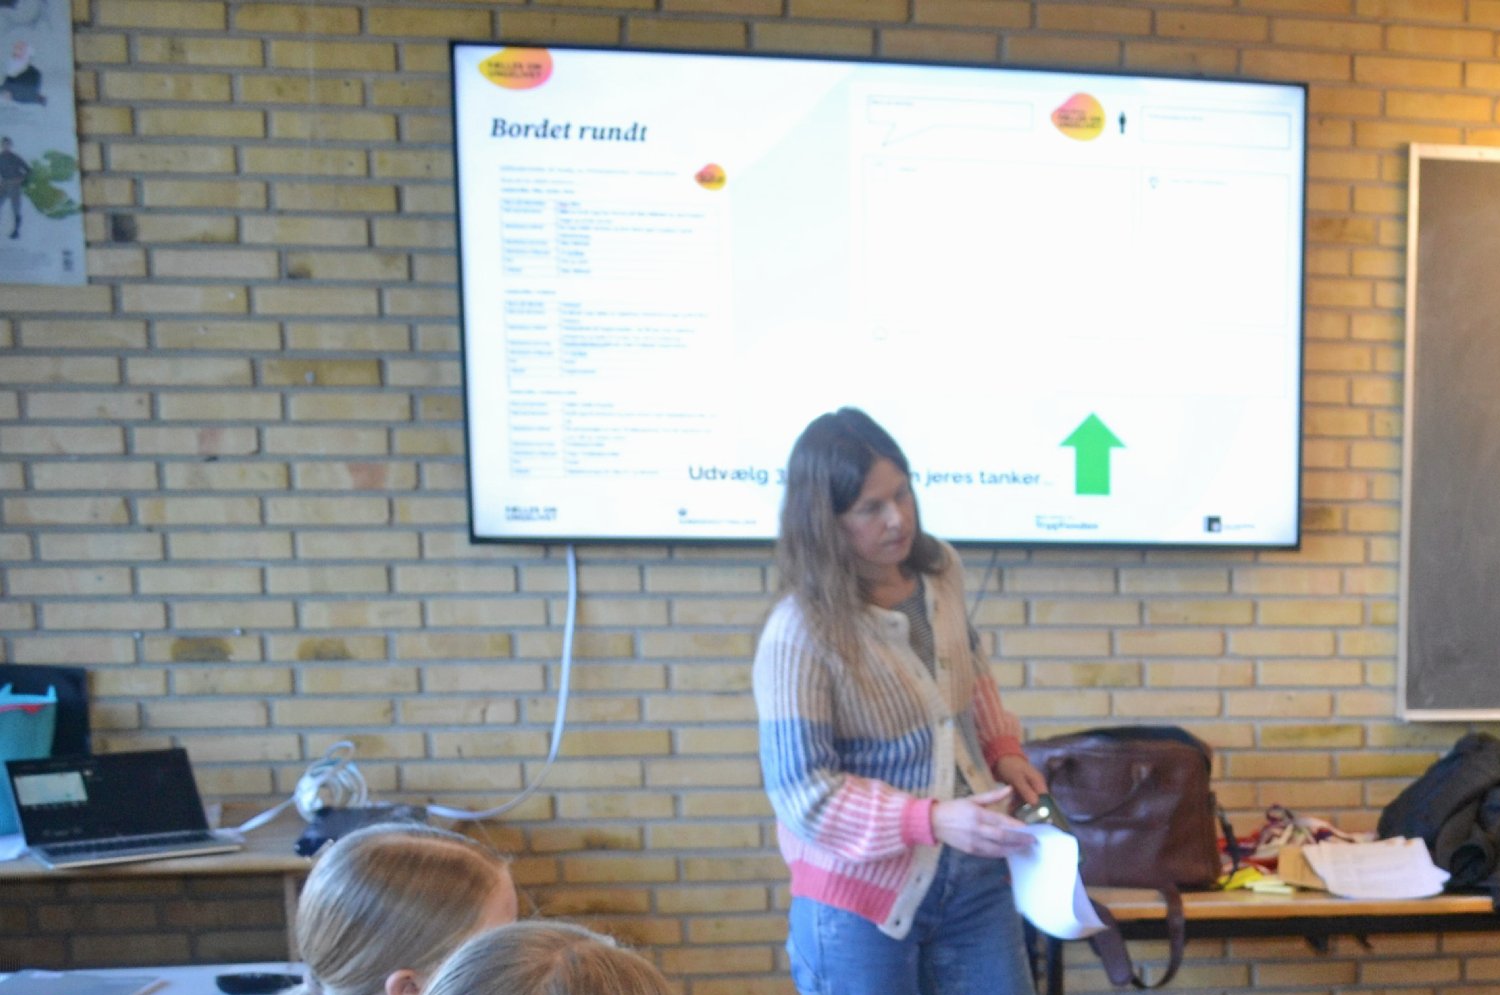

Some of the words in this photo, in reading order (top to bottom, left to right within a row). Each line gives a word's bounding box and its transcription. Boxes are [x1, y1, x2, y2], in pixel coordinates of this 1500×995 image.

[491, 117, 572, 139] Bordet
[578, 122, 648, 142] rundt
[689, 466, 769, 484] Udvælg
[925, 471, 973, 487] jeres
